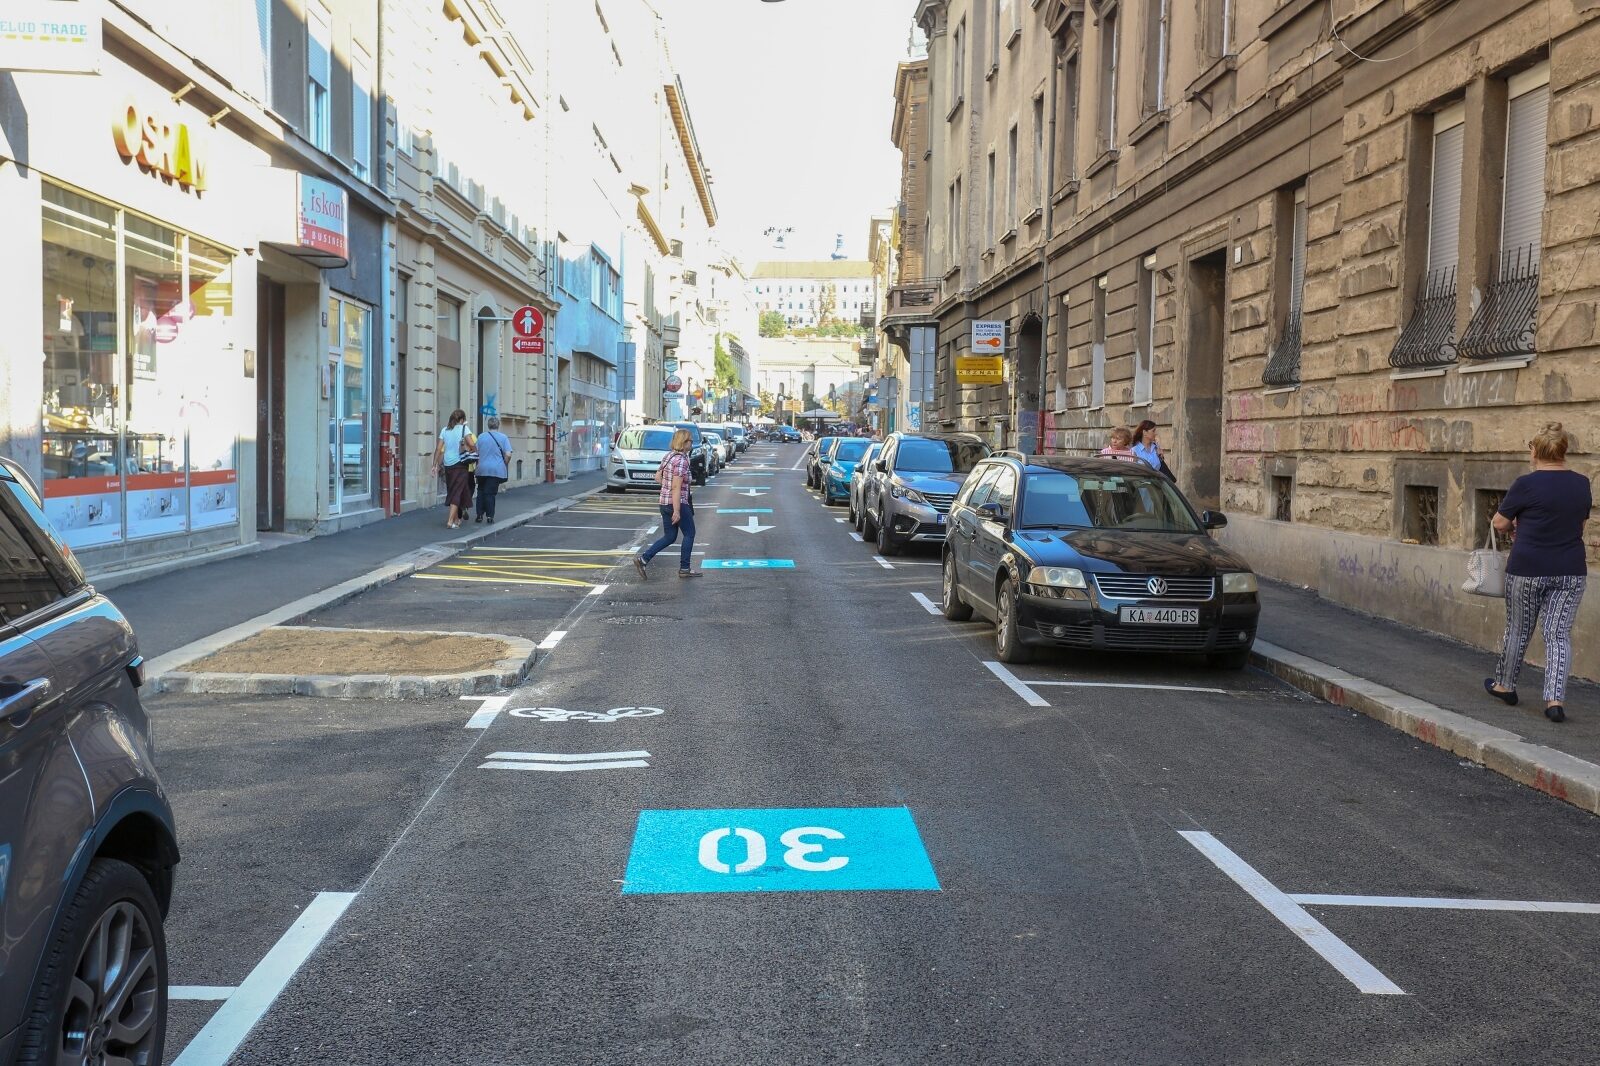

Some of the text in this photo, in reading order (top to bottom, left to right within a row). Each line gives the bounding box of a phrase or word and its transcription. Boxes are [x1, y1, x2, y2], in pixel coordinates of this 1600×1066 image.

[41, 22, 88, 36] TRADE
[1129, 609, 1145, 622] KA
[698, 826, 850, 874] 30
